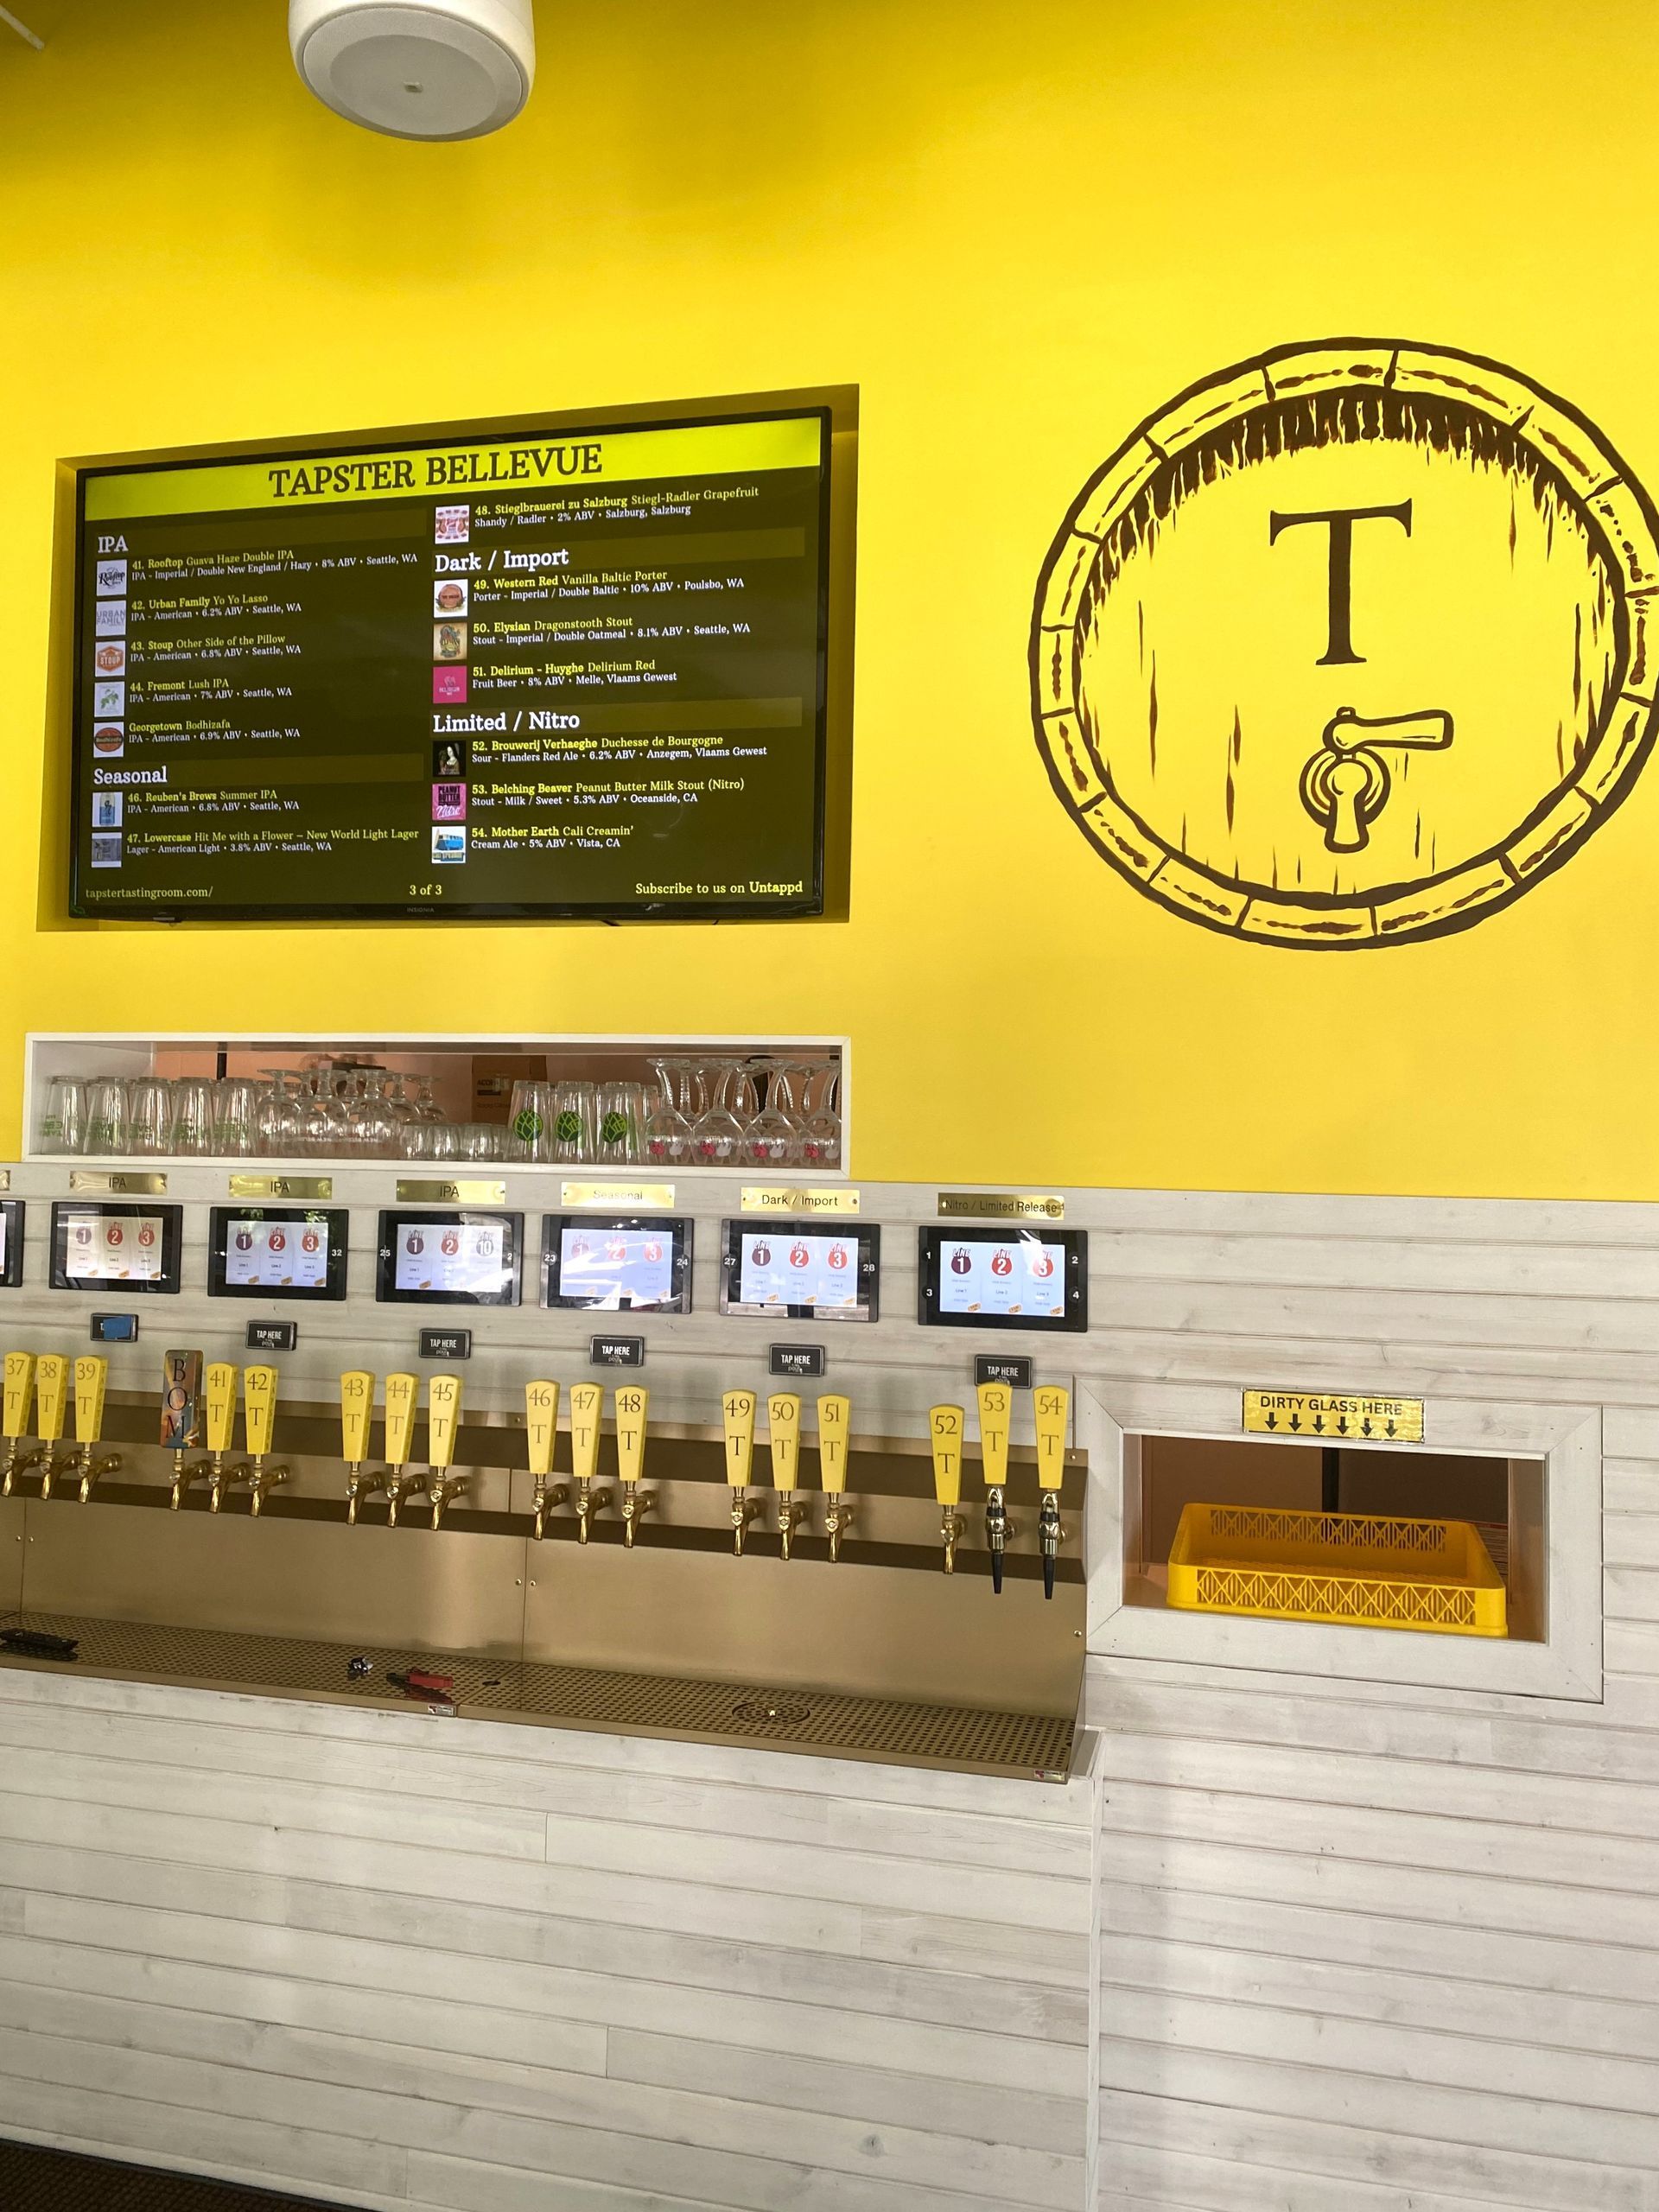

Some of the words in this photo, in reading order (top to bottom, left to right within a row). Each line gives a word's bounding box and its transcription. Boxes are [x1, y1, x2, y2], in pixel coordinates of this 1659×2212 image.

[268, 459, 416, 498] TAPSTER
[426, 443, 603, 486] BELLEVUE
[475, 505, 490, 515] 48.
[495, 499, 564, 516] Stieglbrauerei
[583, 495, 627, 510] Salzburg
[632, 490, 700, 506] Stiegl-Radler
[703, 486, 759, 501] Grapefruit
[98, 535, 129, 553] IPA
[132, 559, 143, 569] 41.
[148, 556, 182, 569] Rooftop
[187, 555, 213, 565] Guava
[217, 553, 239, 563] Haze
[243, 550, 274, 562] Double
[277, 550, 294, 559] IPA
[435, 552, 481, 572] Dark
[503, 547, 569, 573] Import
[474, 580, 489, 590] 49.
[493, 577, 536, 588] Western
[538, 575, 558, 586] Red
[562, 573, 598, 585] Vanilla
[601, 571, 631, 582] Baltic
[635, 569, 667, 581] Porter
[1270, 499, 1412, 665] T
[131, 600, 145, 609] 42.
[149, 598, 176, 608] Urban
[179, 596, 210, 609] Family
[213, 595, 225, 605] Yo
[227, 594, 239, 604] Yo
[242, 593, 268, 603] Lasso
[474, 623, 489, 633] 50.
[493, 620, 531, 634] Elysian
[534, 617, 602, 632] Dragonstooth
[606, 615, 632, 626] Stout
[130, 641, 144, 651] 43.
[148, 639, 173, 652] Stoup
[176, 638, 202, 648] Other
[205, 636, 224, 646] Side
[227, 636, 237, 645] of
[238, 635, 254, 645] the
[257, 633, 285, 644] Pillow
[473, 667, 486, 677] 51.
[490, 664, 533, 676] Delirium
[544, 662, 584, 676] Huyghe
[588, 660, 632, 671] Delirium
[635, 658, 655, 670] Red
[130, 682, 143, 691] 44.
[148, 680, 185, 690] Fremont
[188, 678, 209, 689] Lush
[213, 678, 229, 688] IPA
[129, 721, 182, 734] Georgetown
[186, 719, 230, 729] Bodhizafa
[433, 712, 506, 732] Limited
[528, 709, 580, 729] Nitro
[472, 741, 487, 751] 52.
[492, 740, 540, 753] Brouwerij
[542, 737, 597, 751] Verhaeghe
[601, 735, 648, 747] Duchesse
[652, 735, 664, 746] de
[668, 734, 722, 747] Bourgogne
[93, 765, 168, 784] Seasonal
[128, 792, 142, 802] 46.
[189, 791, 216, 800] Brews
[220, 790, 257, 799] Summer
[261, 789, 277, 798] IPA
[472, 785, 487, 794] 53.
[491, 783, 535, 796] Belching
[537, 783, 572, 793] Beaver
[575, 782, 611, 791] Peanut
[614, 781, 647, 791] Butter
[651, 779, 674, 790] Milk
[677, 779, 704, 790] Stout
[709, 779, 744, 791] (Nitro)
[127, 833, 140, 842] 47.
[144, 832, 191, 842] Lowercase
[194, 831, 209, 841] Hit
[213, 831, 226, 841] Me
[229, 830, 250, 840] with
[262, 830, 293, 840] Flower
[307, 830, 327, 839] New
[330, 829, 359, 838] World
[363, 828, 388, 840] Light
[391, 828, 418, 840] Lager
[472, 828, 487, 837] 54.
[492, 826, 528, 836] Mother
[531, 826, 559, 836] Earth
[563, 825, 583, 836] Cali
[86, 886, 213, 899] tapstertastingroom.com/
[410, 884, 416, 895] 3
[420, 883, 432, 895] of
[435, 884, 442, 894] 3
[635, 881, 692, 893] Subscribe
[696, 881, 709, 893] to
[713, 884, 726, 893] us
[730, 884, 745, 893] on
[749, 880, 803, 895] Untappd
[109, 1177, 126, 1189] IPA
[270, 1180, 289, 1193] IPA
[439, 1185, 460, 1198] IPA
[594, 1189, 643, 1201] Seasonal
[762, 1194, 788, 1206] Dark
[800, 1195, 838, 1208] Import
[945, 1198, 968, 1210] Nitro
[980, 1200, 1014, 1211] Limited
[257, 1330, 267, 1338] TAP
[268, 1331, 283, 1339] HERE
[430, 1338, 442, 1347] TAP
[442, 1339, 457, 1348] HERE
[602, 1345, 613, 1354] TAP
[614, 1346, 630, 1355] HERE
[7, 1358, 24, 1376] 37
[781, 1355, 793, 1363] TAP
[794, 1355, 810, 1364] HERE
[40, 1361, 57, 1379] 38
[77, 1363, 96, 1381] 39
[210, 1370, 226, 1388] 41
[987, 1366, 1000, 1376] TAP
[1001, 1367, 1019, 1376] HERE
[247, 1373, 268, 1391] 42
[344, 1378, 365, 1396] 43
[387, 1380, 410, 1399] 44
[432, 1382, 453, 1402] 45
[528, 1388, 550, 1407] 46
[573, 1391, 595, 1410] 47
[618, 1393, 641, 1413] 48
[725, 1398, 751, 1418] 49
[982, 1392, 1006, 1412] 53
[1037, 1395, 1064, 1415] 54
[1261, 1396, 1305, 1410] DIRTY
[1309, 1399, 1357, 1413] GLASS
[1363, 1402, 1402, 1415] HERE
[771, 1402, 795, 1421] 50
[824, 1402, 841, 1423] 51
[934, 1414, 958, 1435] 52
